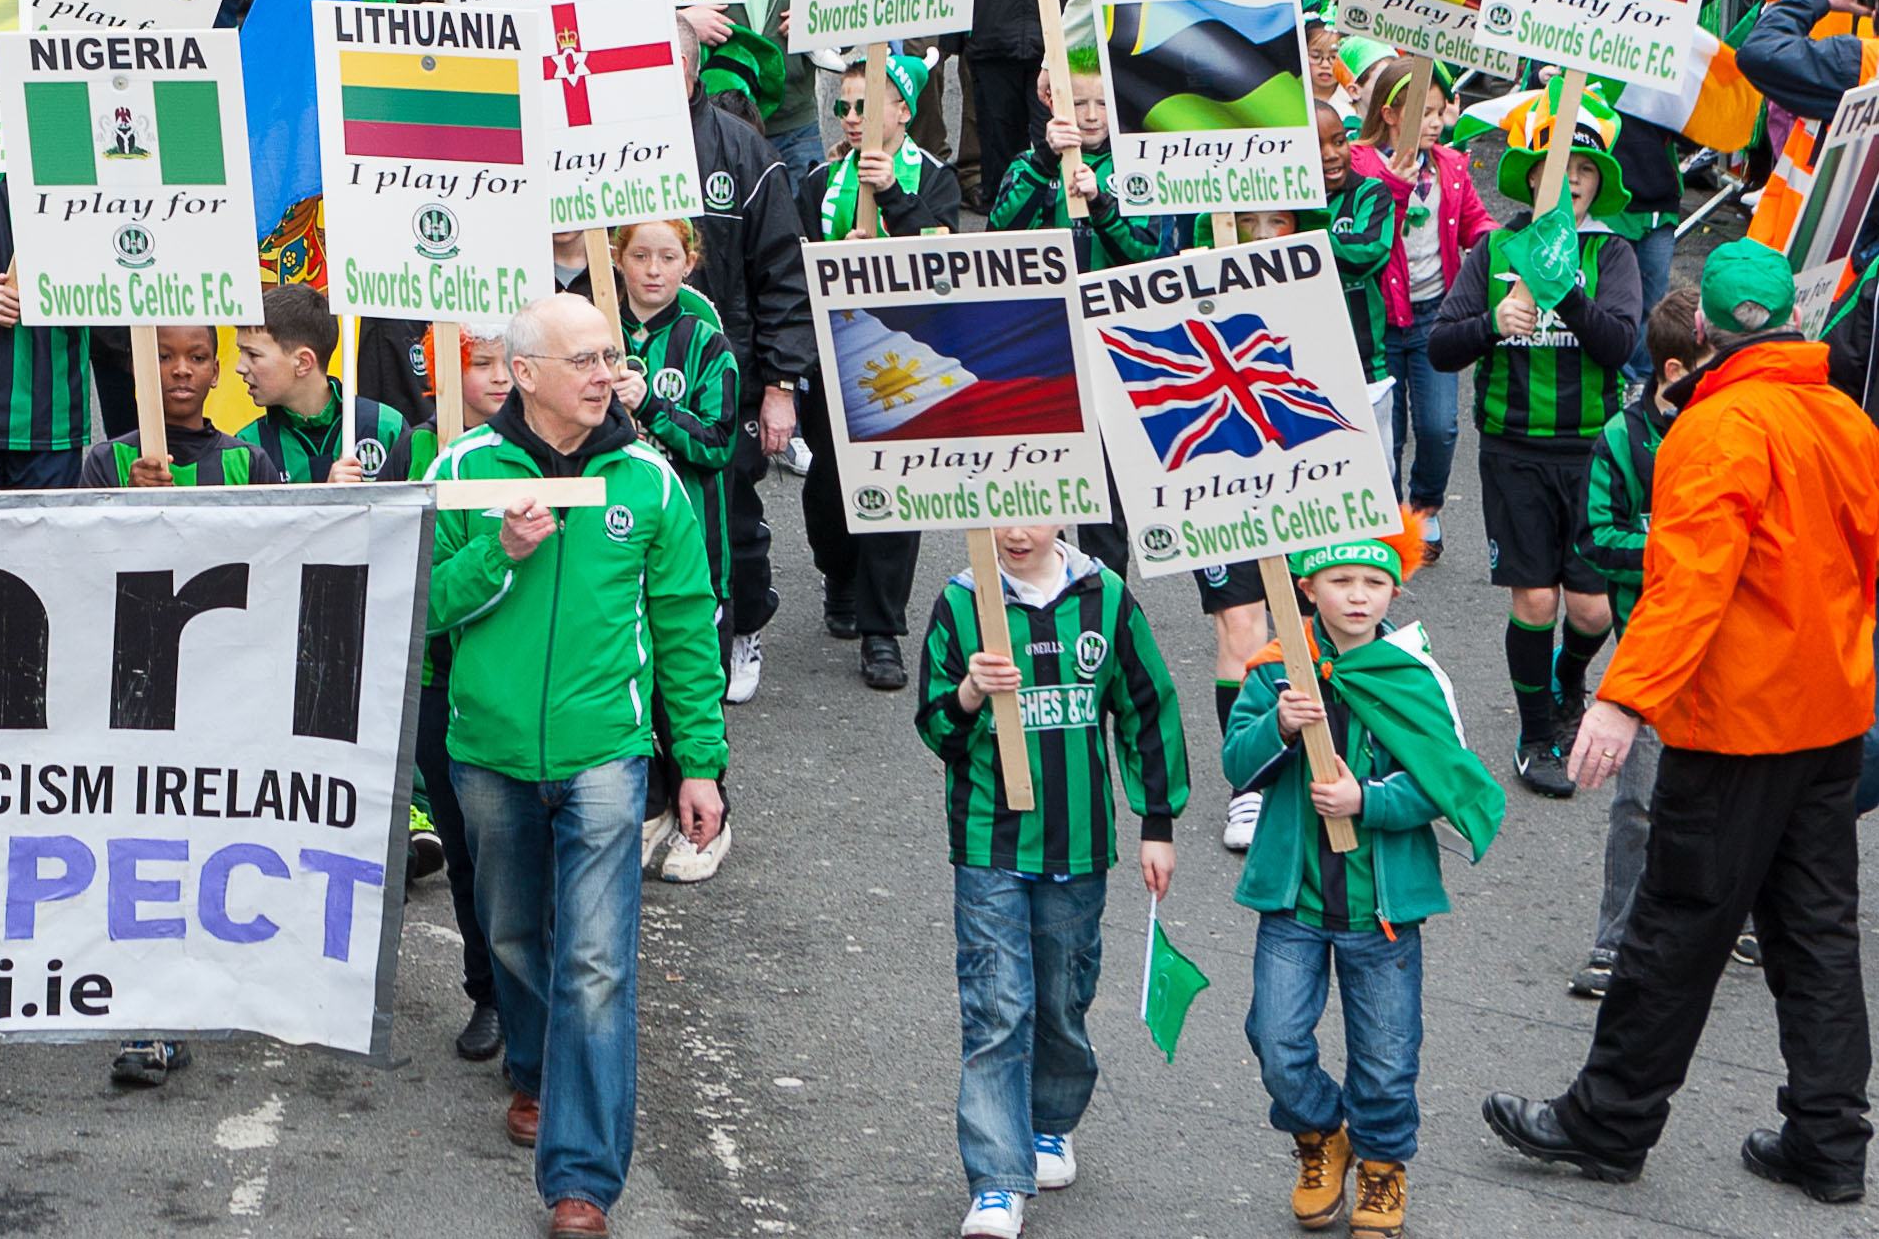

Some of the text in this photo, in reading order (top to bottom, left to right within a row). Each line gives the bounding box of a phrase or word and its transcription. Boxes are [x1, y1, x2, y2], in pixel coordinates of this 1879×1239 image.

[335, 6, 521, 51] LITHUANIA
[1373, 12, 1431, 52] Swords
[1435, 25, 1481, 63] Celtic
[1483, 39, 1513, 77] F.C.
[1517, 12, 1583, 61] Swords
[1586, 29, 1642, 72] Celtic
[1644, 43, 1677, 82] F.C.
[29, 36, 207, 72] NIGERIA
[614, 142, 670, 171] for
[1136, 133, 1293, 168] I play for
[348, 163, 527, 200] I play for
[601, 172, 697, 219] Celtic F.C.
[1156, 167, 1317, 206] Swords Celtic F.C.
[33, 191, 227, 222] I play for
[345, 257, 491, 313] Swords Celtic
[822, 246, 1068, 297] PHILIPPINES
[1079, 243, 1322, 319] ENGLAND
[39, 272, 243, 317] Swords Celtic F.C.
[870, 443, 1070, 478] I play for
[896, 478, 1100, 523] Swords Celtic F.C.
[1152, 459, 1351, 511] I play for
[1181, 491, 1389, 560] Swords Celtic F.C.
[1025, 641, 1065, 657] O'NEILLS
[135, 767, 358, 830] IRELAND
